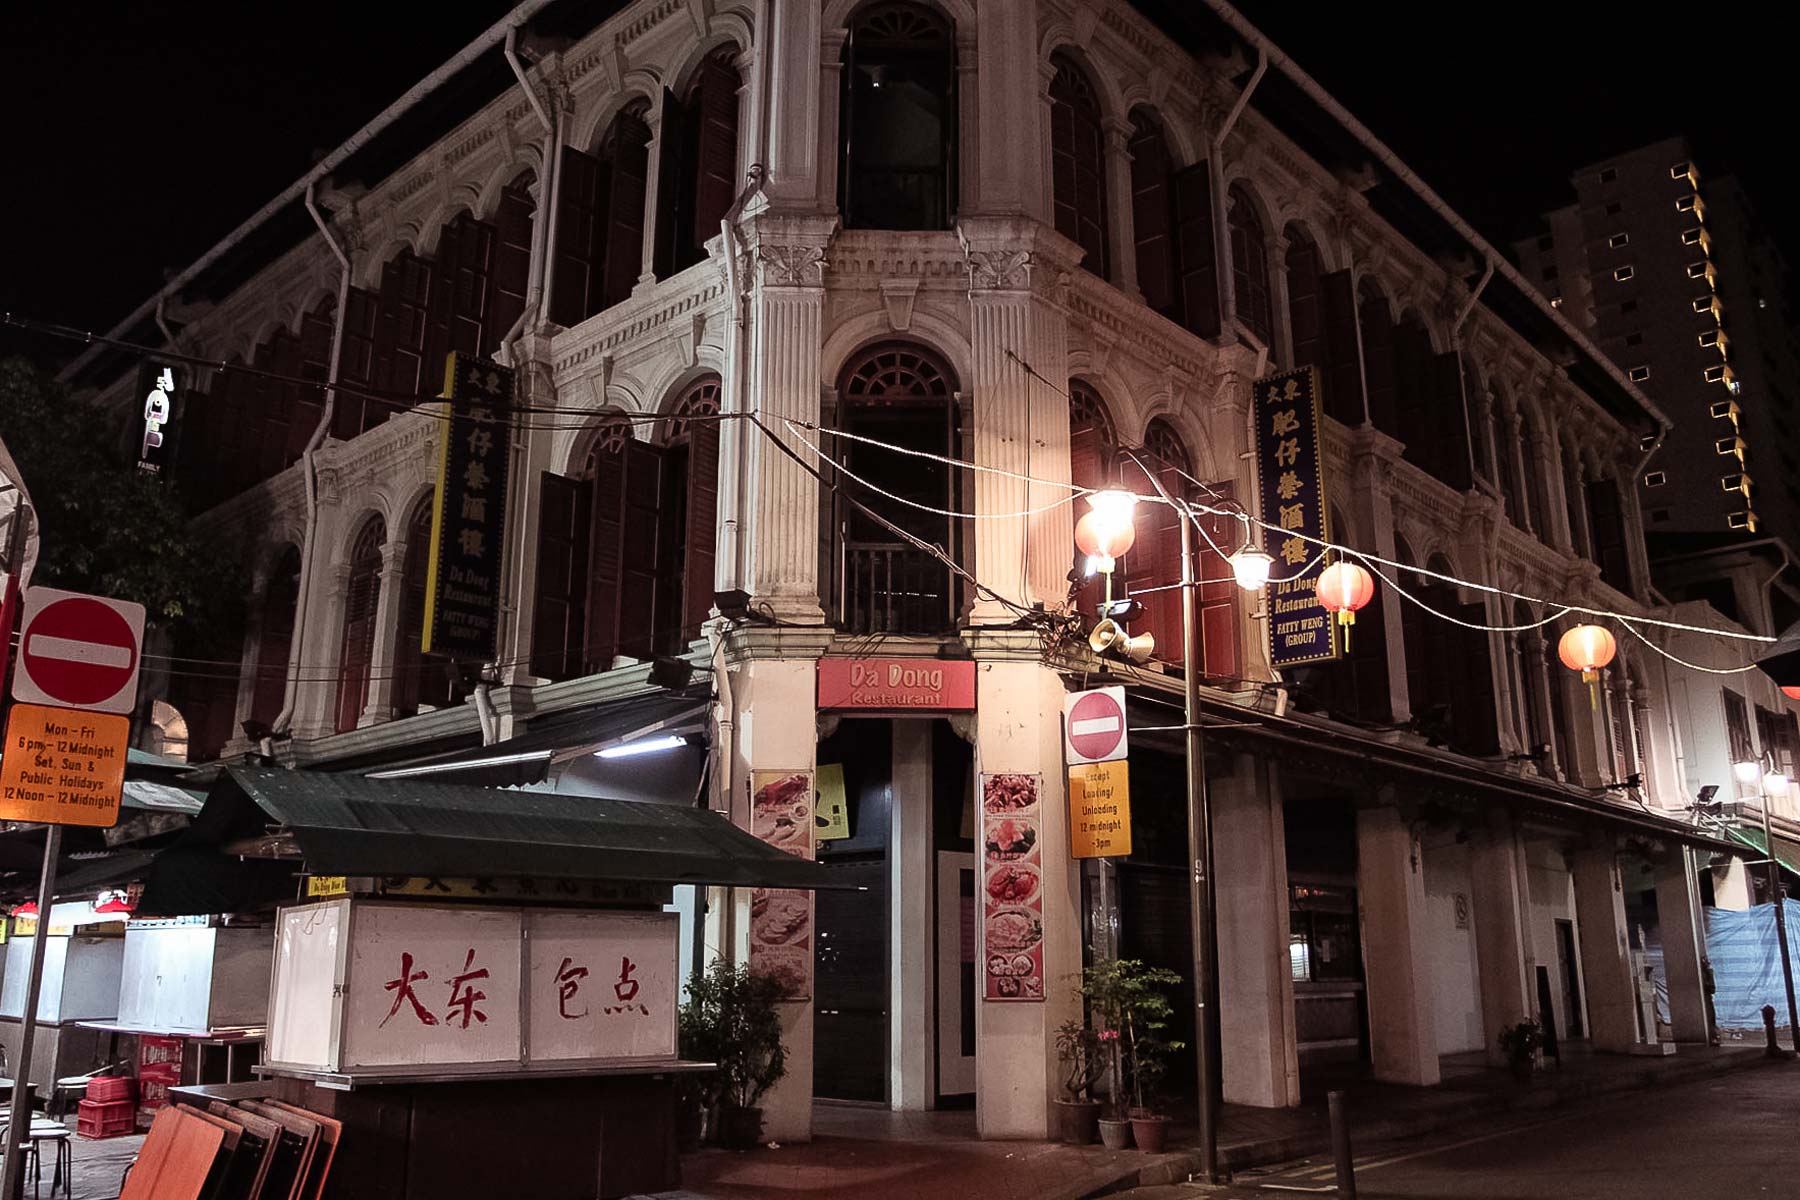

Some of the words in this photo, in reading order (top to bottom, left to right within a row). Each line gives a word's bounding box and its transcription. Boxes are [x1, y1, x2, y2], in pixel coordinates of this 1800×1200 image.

[1275, 596, 1320, 614] Restauran
[1277, 620, 1300, 635] FATTY
[1301, 616, 1324, 631] WENG
[1285, 630, 1316, 648] (GROUP)
[851, 664, 879, 688] Da
[888, 664, 943, 691] Dong
[852, 691, 941, 706] Restaurant
[45, 722, 68, 736] Mon
[81, 726, 95, 739] Fri
[57, 741, 67, 753] 12
[69, 742, 115, 759] Midnight
[62, 758, 82, 771] Sun
[87, 760, 95, 772] &
[20, 771, 53, 785] Public
[59, 775, 104, 792] Holidays
[4, 787, 15, 799] 12
[16, 788, 44, 801] Noon
[58, 792, 68, 804] 12
[69, 793, 115, 810] Midnight
[1082, 805, 1117, 816] Unloading
[1080, 822, 1088, 833] 12
